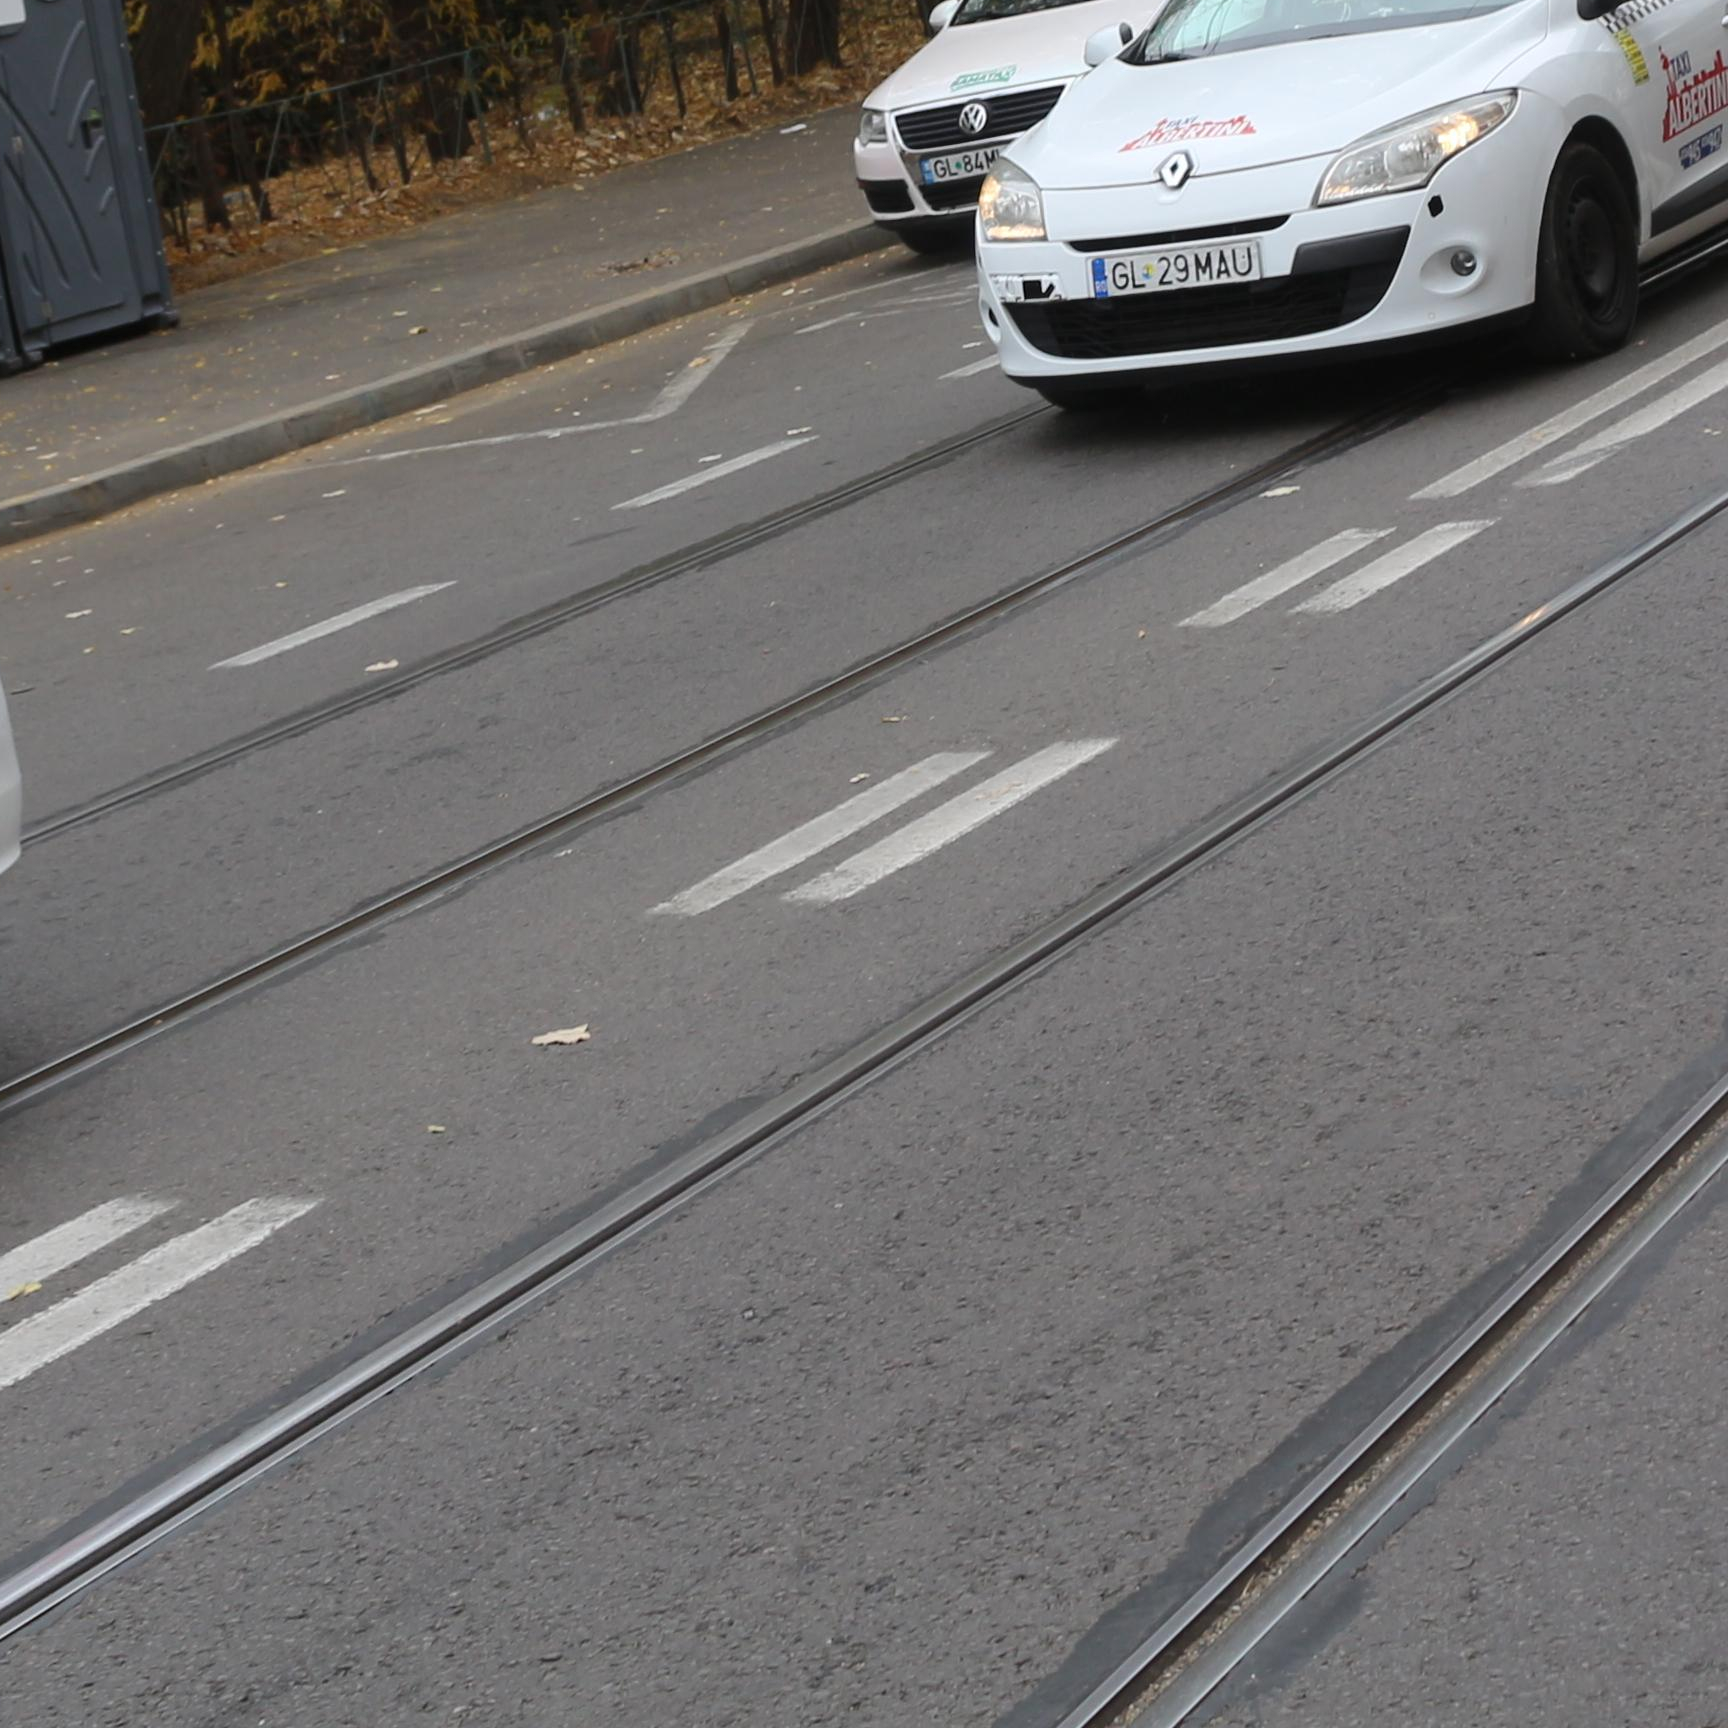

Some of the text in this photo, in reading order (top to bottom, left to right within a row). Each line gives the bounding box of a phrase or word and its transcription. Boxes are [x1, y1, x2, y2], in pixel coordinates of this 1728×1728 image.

[1670, 50, 1692, 80] TAXI
[933, 158, 959, 179] GL
[1111, 260, 1146, 291] GL
